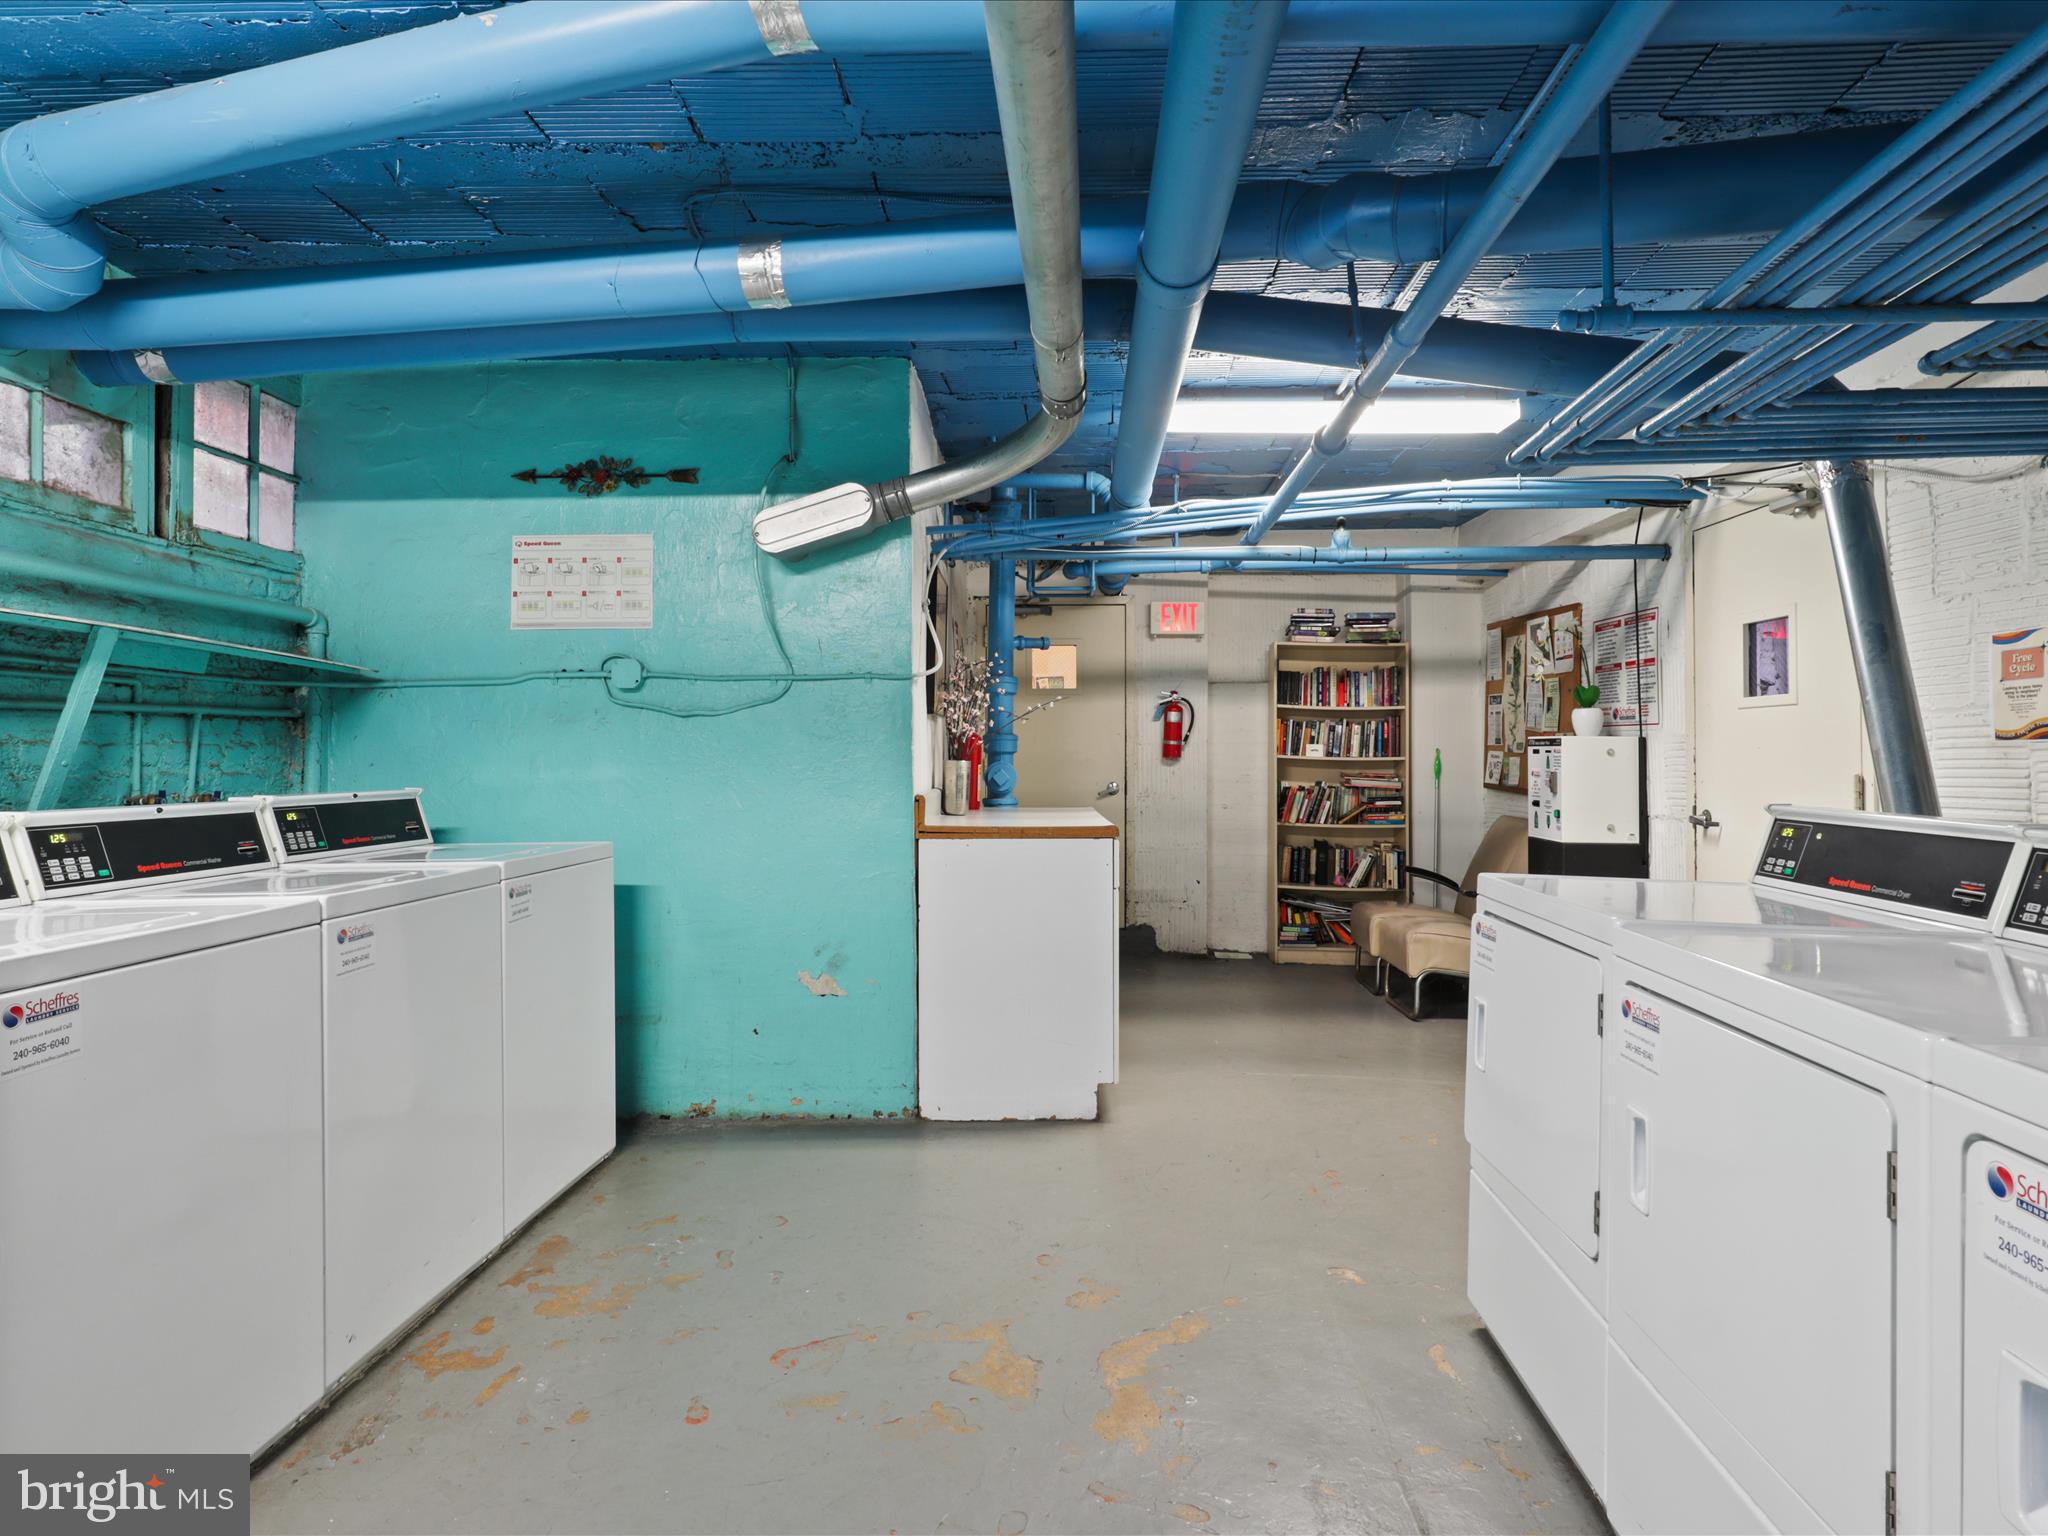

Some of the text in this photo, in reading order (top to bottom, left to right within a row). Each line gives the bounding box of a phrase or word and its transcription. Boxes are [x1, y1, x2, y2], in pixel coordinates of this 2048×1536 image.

[1160, 602, 1200, 632] EXIT
[2012, 654, 2033, 664] Free
[2009, 664, 2036, 677] Cycle
[137, 863, 160, 873] Speed
[160, 861, 182, 869] Queen
[1828, 876, 1850, 887] Speed
[1850, 880, 1872, 891] Queen
[25, 992, 79, 1017] Scheffres
[13, 1036, 70, 1061] 240-965-6040
